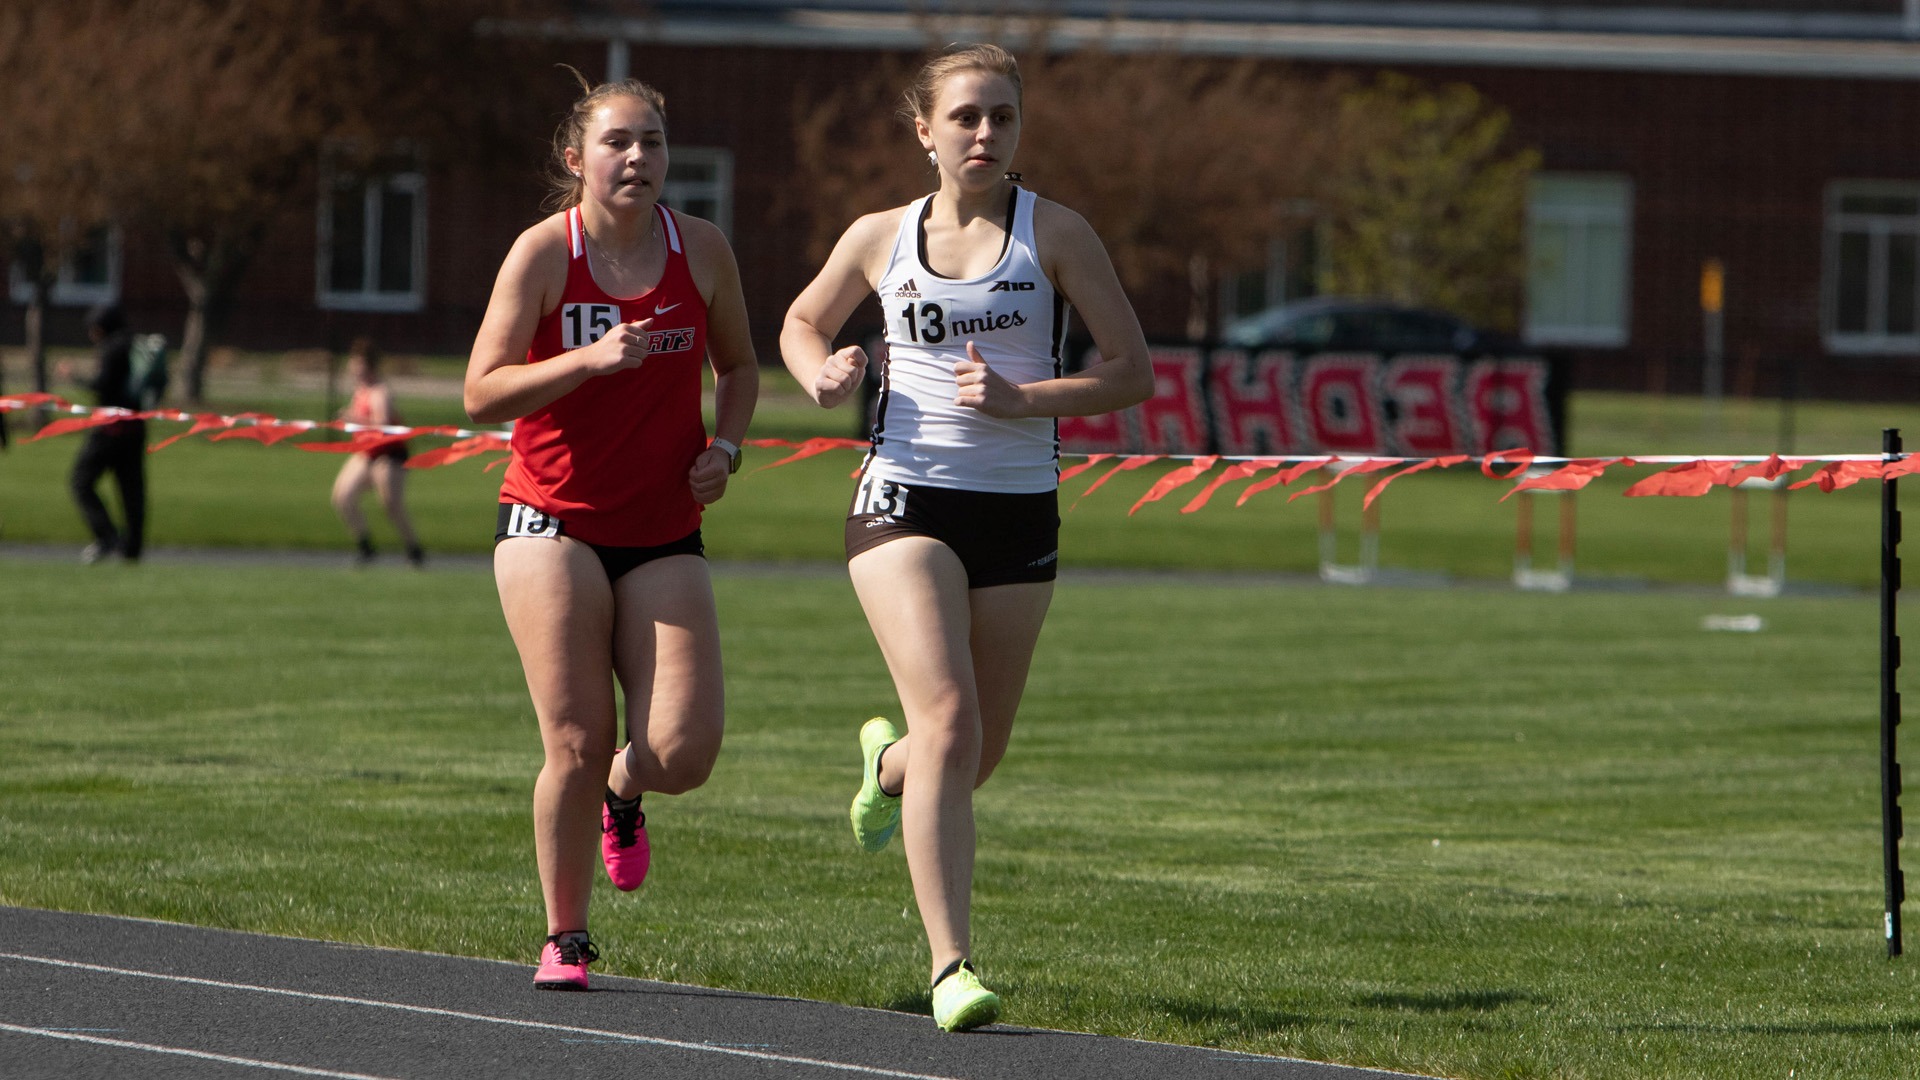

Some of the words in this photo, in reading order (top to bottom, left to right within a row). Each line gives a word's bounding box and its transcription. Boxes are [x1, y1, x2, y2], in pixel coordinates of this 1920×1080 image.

[895, 291, 922, 299] adidas
[565, 304, 612, 347] 15
[902, 302, 946, 344] 13
[952, 309, 1027, 336] nnies
[648, 329, 695, 352] RTS
[862, 476, 900, 514] 13
